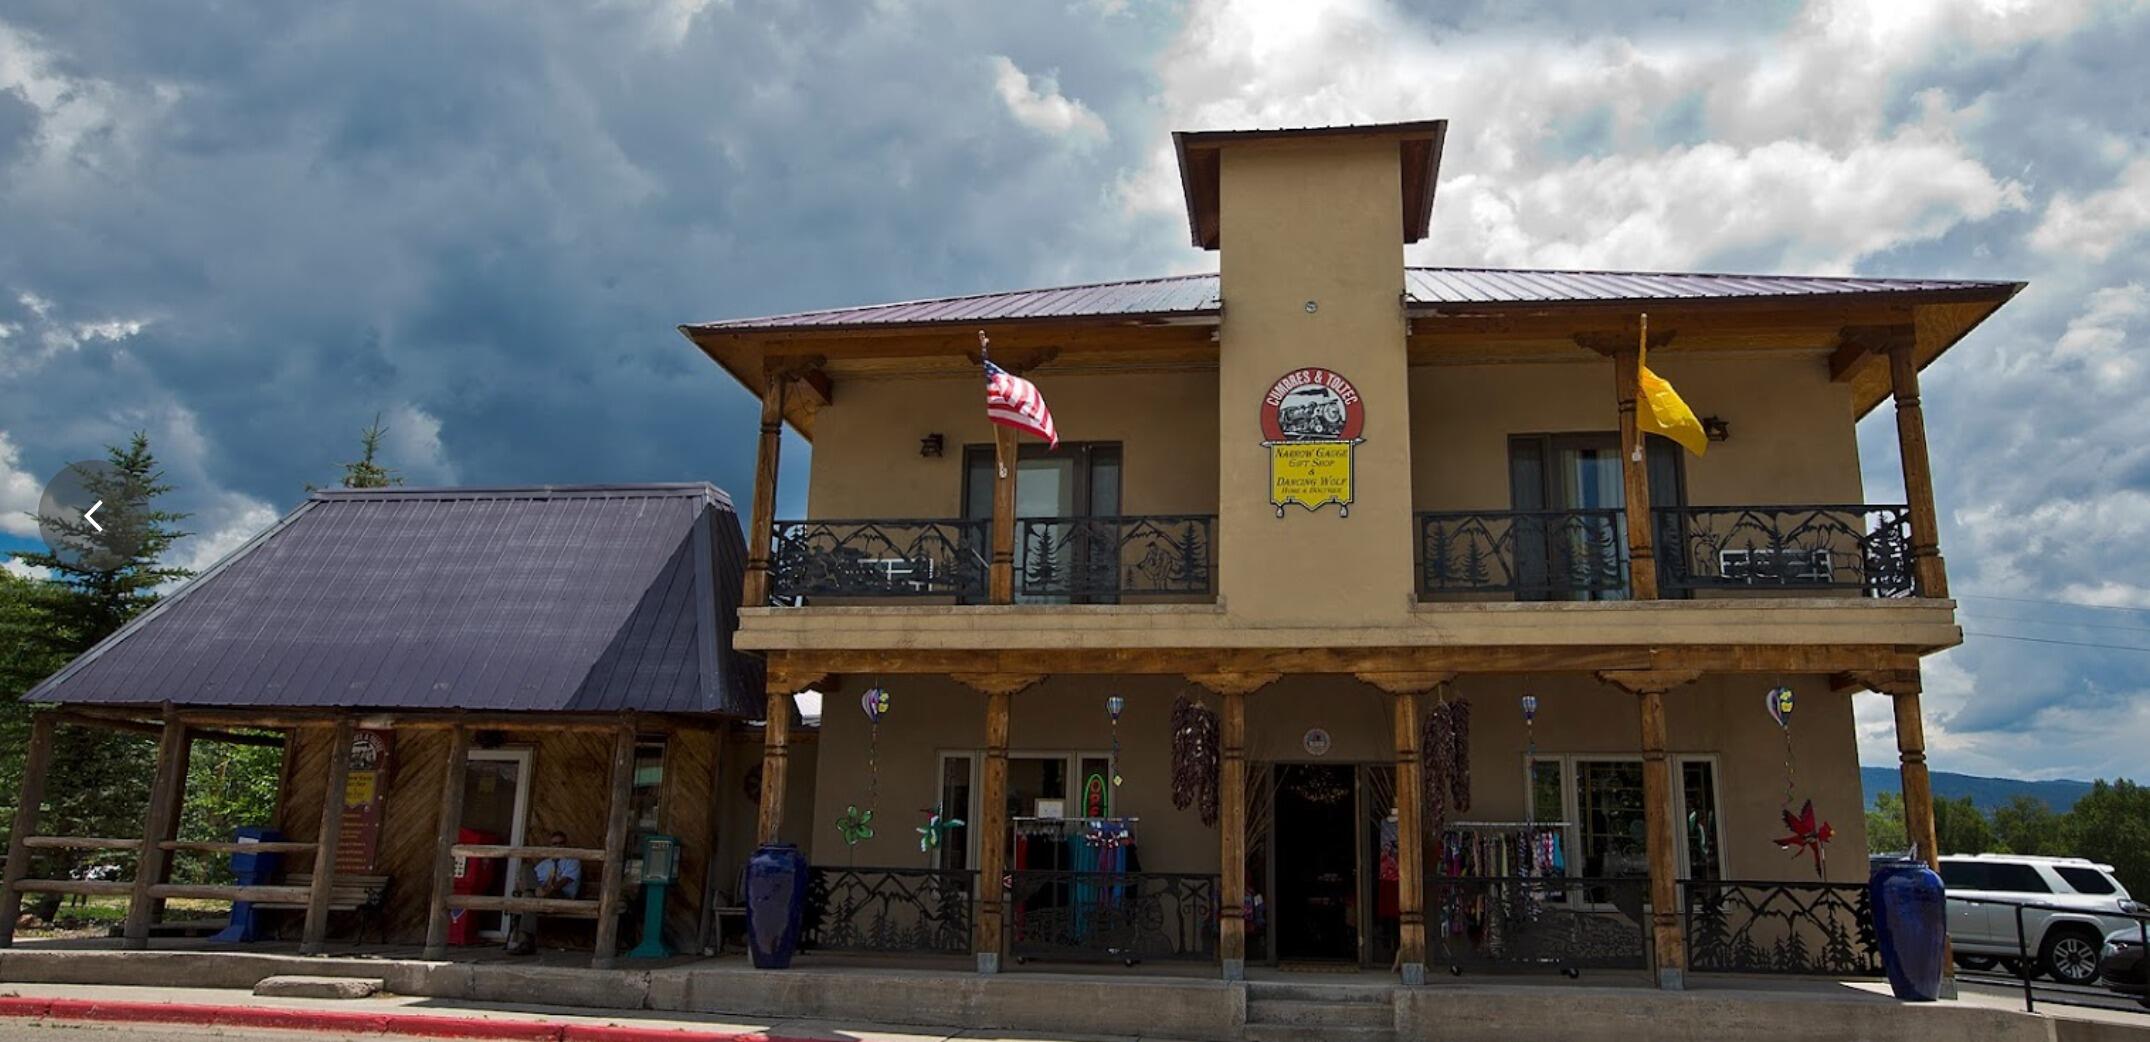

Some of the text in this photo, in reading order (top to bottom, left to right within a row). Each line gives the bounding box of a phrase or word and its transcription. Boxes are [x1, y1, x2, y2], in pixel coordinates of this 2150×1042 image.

[1266, 370, 1358, 406] CUMBRES & TOLTEC
[1275, 447, 1348, 458] NARROW GAUGE
[1289, 458, 1335, 467] GIFT SHOP
[1276, 475, 1348, 486] DANCING WOLF
